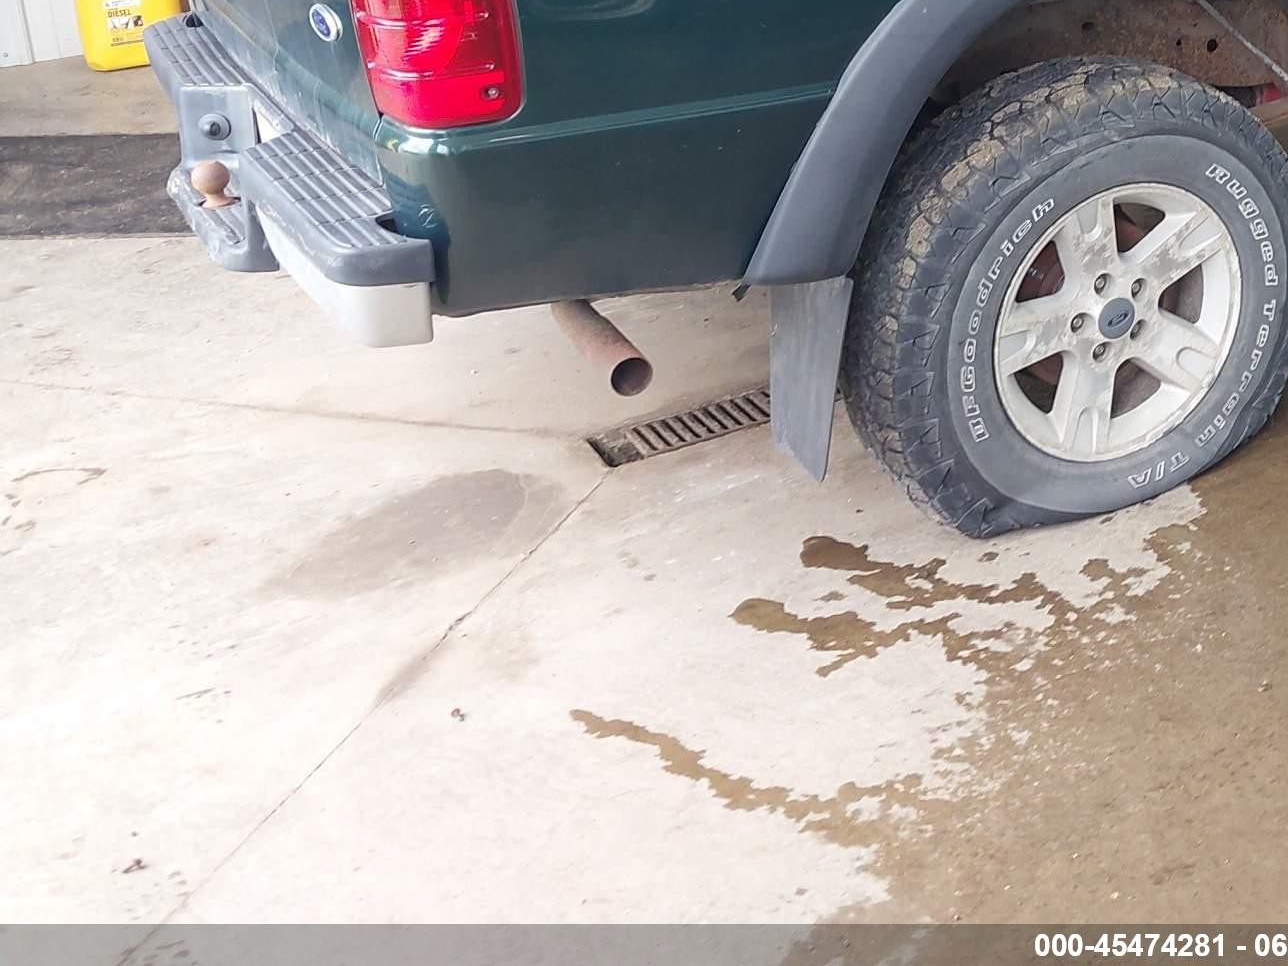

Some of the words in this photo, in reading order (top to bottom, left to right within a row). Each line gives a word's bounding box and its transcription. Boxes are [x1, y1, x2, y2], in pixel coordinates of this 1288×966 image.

[107, 9, 131, 18] DIESEL
[1205, 162, 1278, 287] Rugged
[960, 197, 1057, 443] BFGoodrich
[1194, 298, 1277, 447] Terrain
[1127, 450, 1191, 489] T/A
